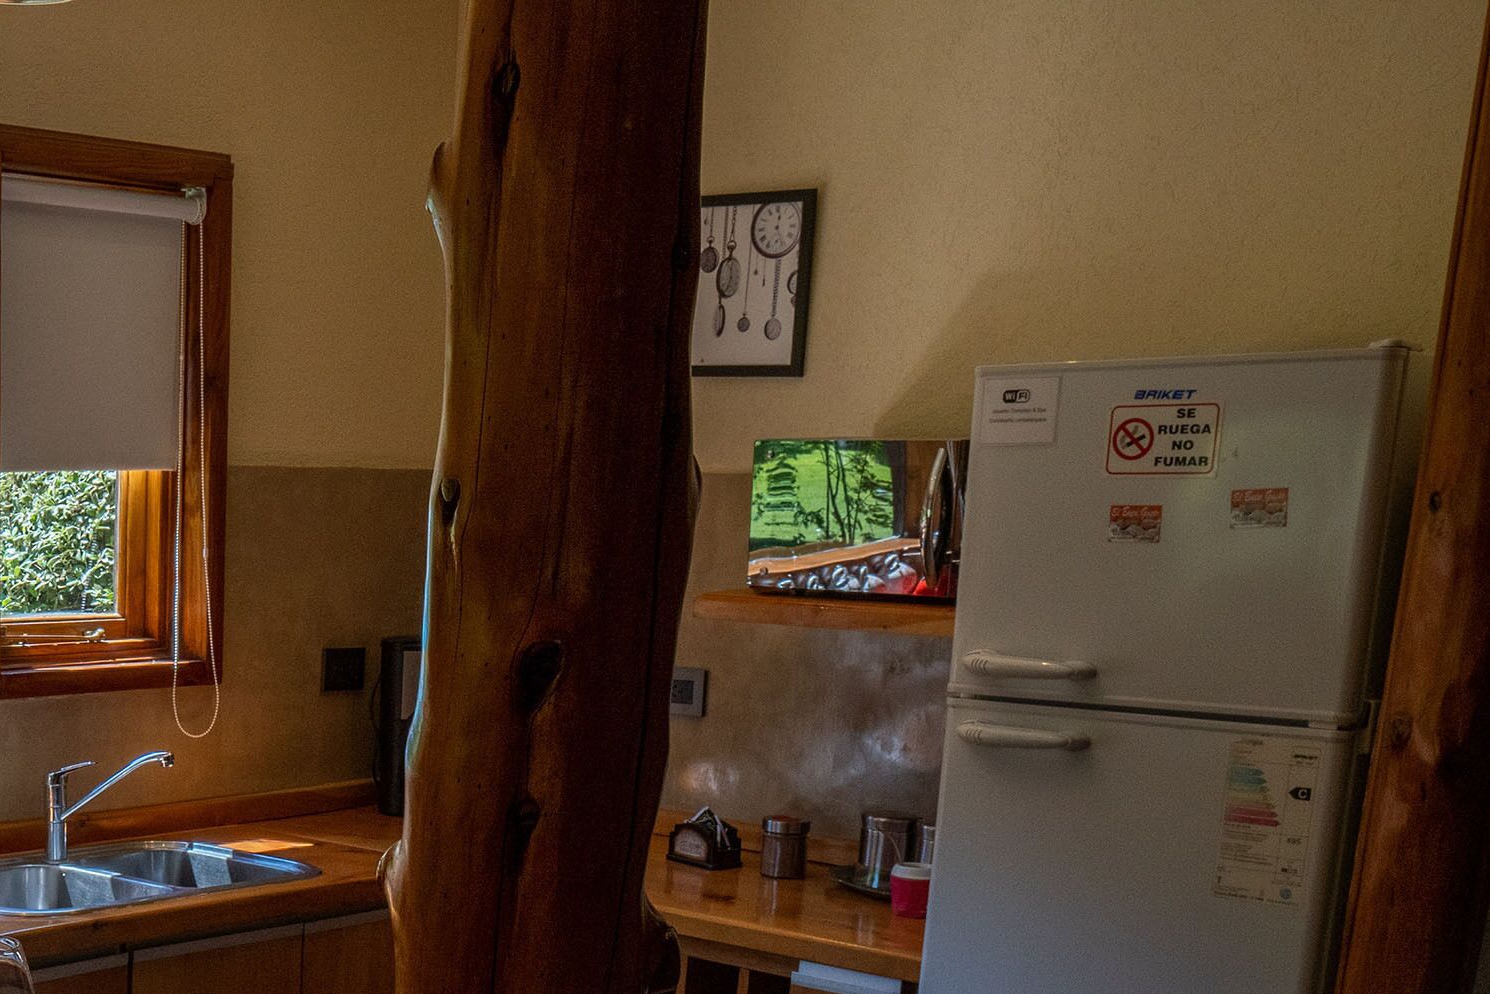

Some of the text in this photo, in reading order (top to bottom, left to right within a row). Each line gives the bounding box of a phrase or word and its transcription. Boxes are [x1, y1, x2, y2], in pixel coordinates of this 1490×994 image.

[1134, 389, 1198, 400] BRIKET
[1176, 408, 1197, 419] SE
[1157, 424, 1212, 435] RUEGA
[1171, 440, 1194, 451] NO
[1154, 456, 1209, 467] FUMAR
